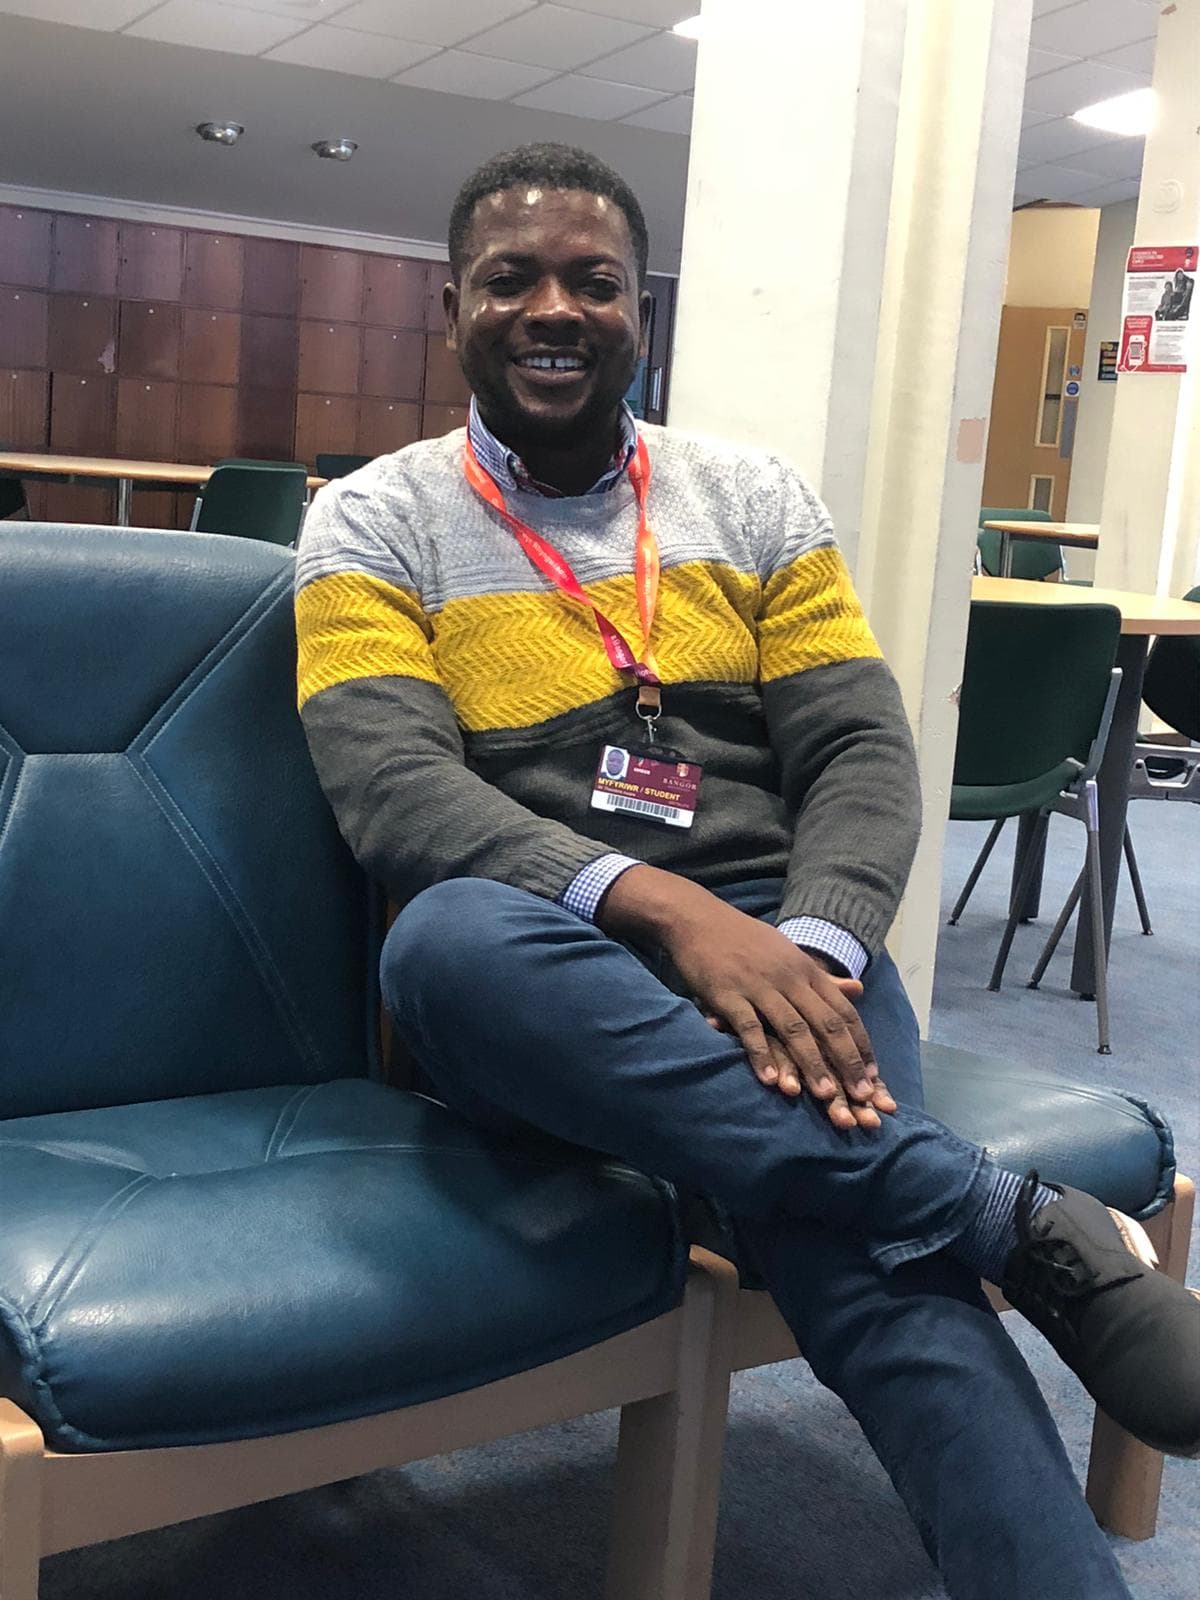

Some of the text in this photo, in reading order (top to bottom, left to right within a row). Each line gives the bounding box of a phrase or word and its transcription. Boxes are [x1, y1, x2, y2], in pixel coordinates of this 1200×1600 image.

[598, 777, 640, 794] MYFYRIWR
[644, 786, 681, 801] STUDENT
[662, 778, 697, 791] BANGOR
